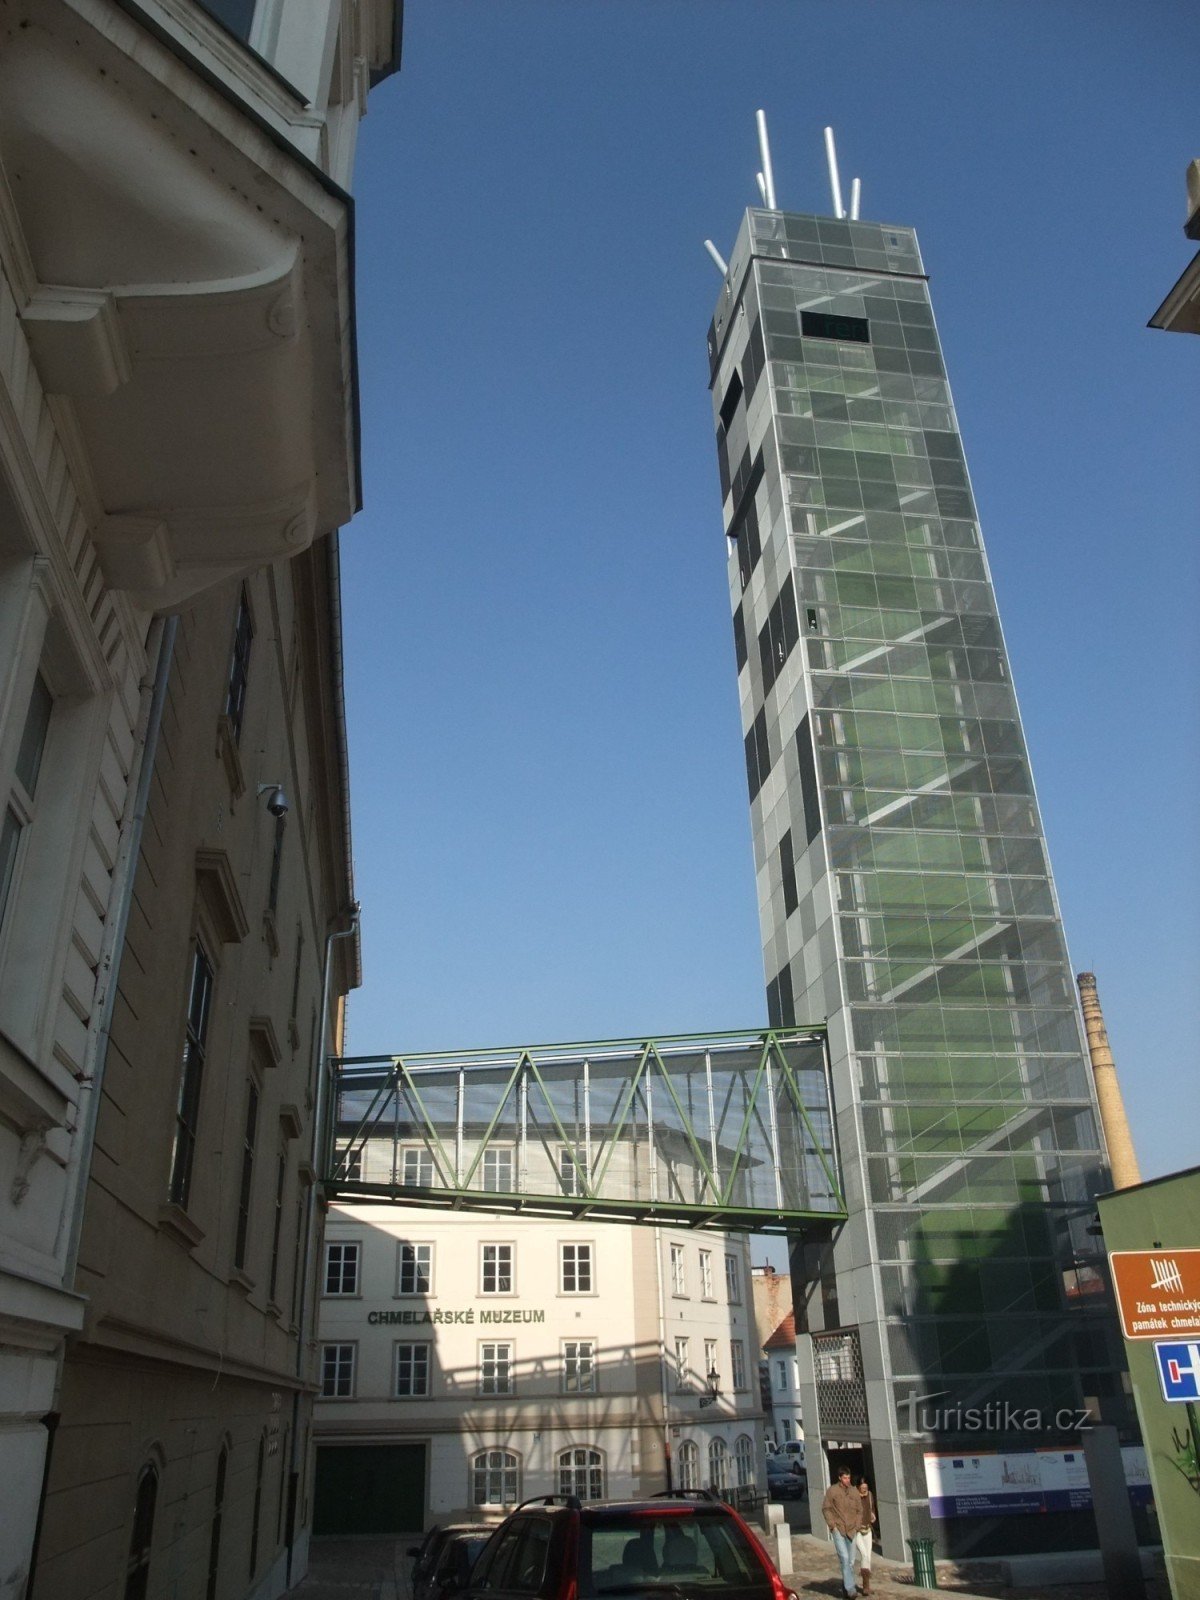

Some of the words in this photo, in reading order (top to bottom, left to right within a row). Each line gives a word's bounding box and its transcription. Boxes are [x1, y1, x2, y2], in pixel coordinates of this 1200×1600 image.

[1136, 1302, 1156, 1313] Zóna
[368, 1308, 474, 1324] CHMELAŘSKÉ
[480, 1310, 545, 1323] MUZEUM
[1132, 1318, 1168, 1333] památek
[1171, 1316, 1200, 1328] chmela
